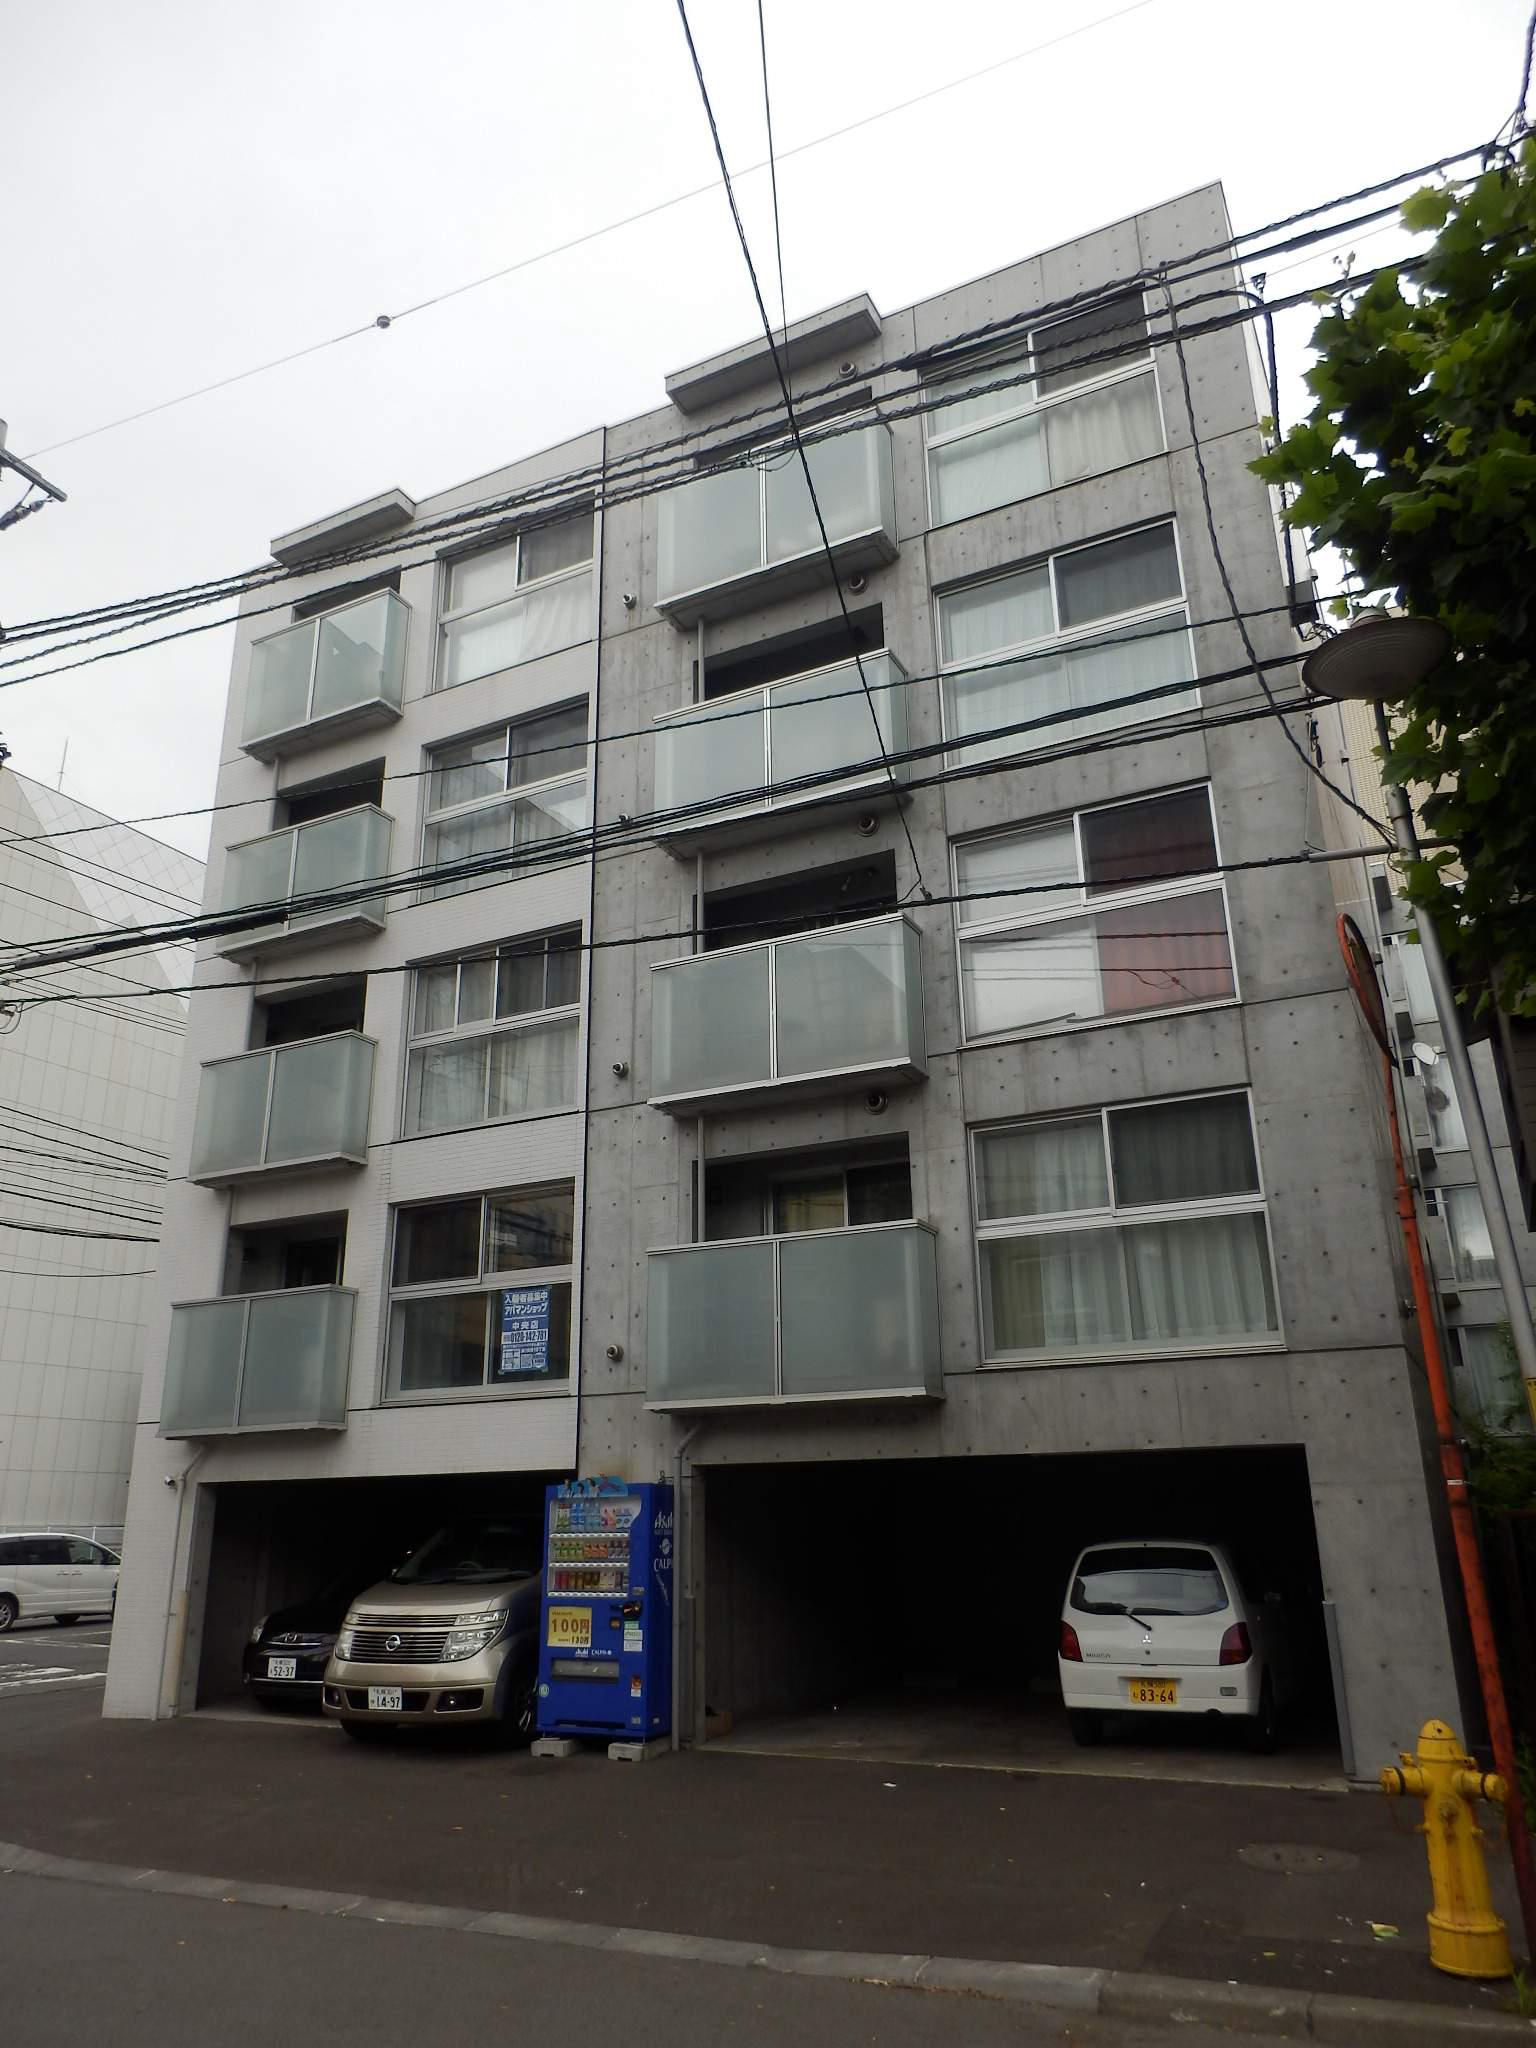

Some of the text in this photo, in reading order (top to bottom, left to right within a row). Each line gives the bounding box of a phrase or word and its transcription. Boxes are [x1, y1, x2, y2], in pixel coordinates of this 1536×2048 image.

[551, 1618, 590, 1635] 100円
[273, 1666, 295, 1677] 52-37
[376, 1696, 401, 1708] 14-97
[1140, 1689, 1174, 1703] 83-64
